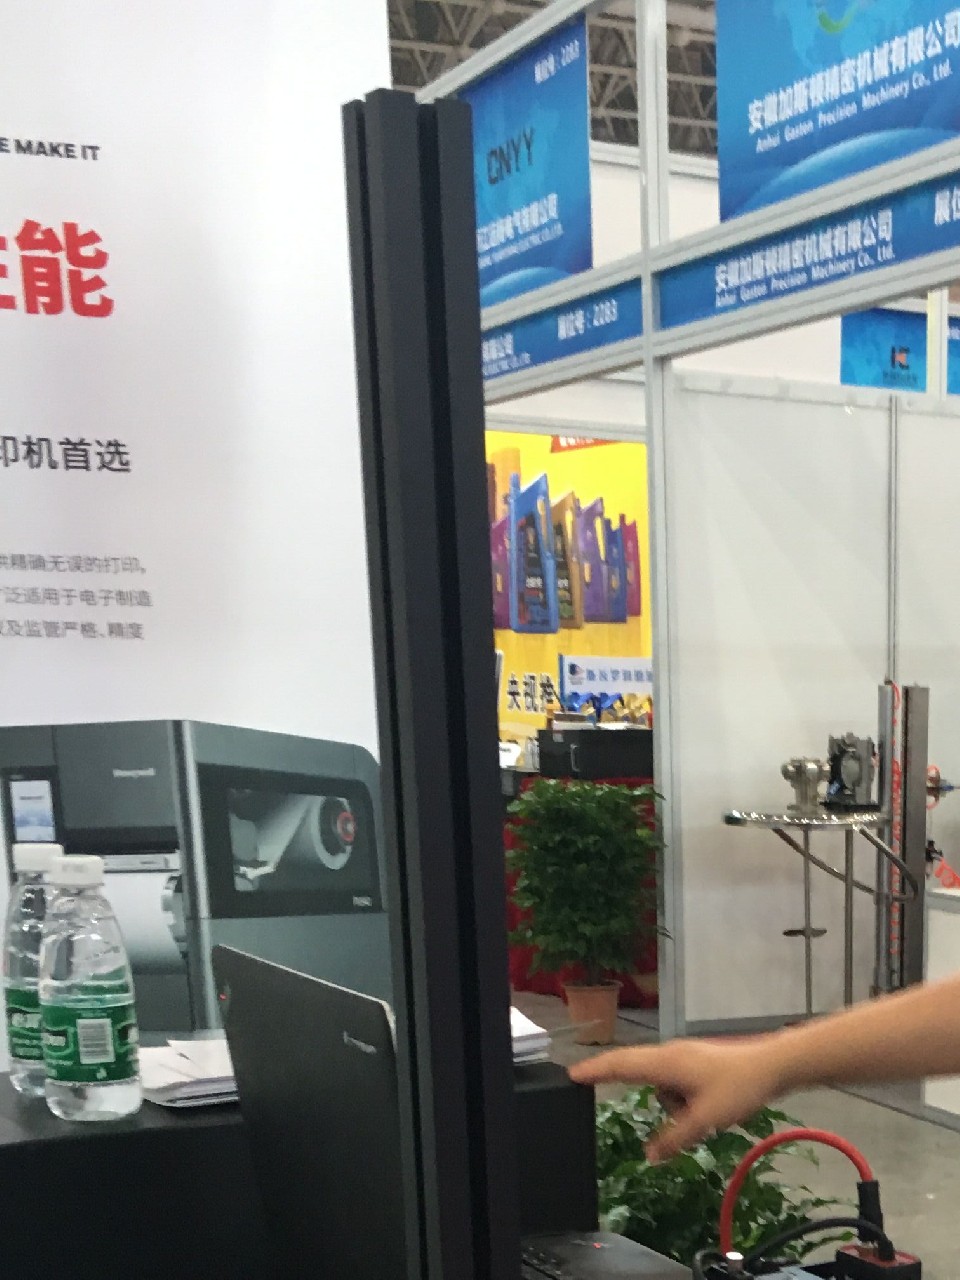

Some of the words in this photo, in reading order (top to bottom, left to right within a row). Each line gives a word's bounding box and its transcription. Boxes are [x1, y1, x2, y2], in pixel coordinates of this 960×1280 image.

[14, 139, 77, 159] MAKE
[81, 145, 101, 160] IT
[0, 586, 153, 607] 泛适用于电子制造
[0, 619, 145, 640] 及监管严格、精度
